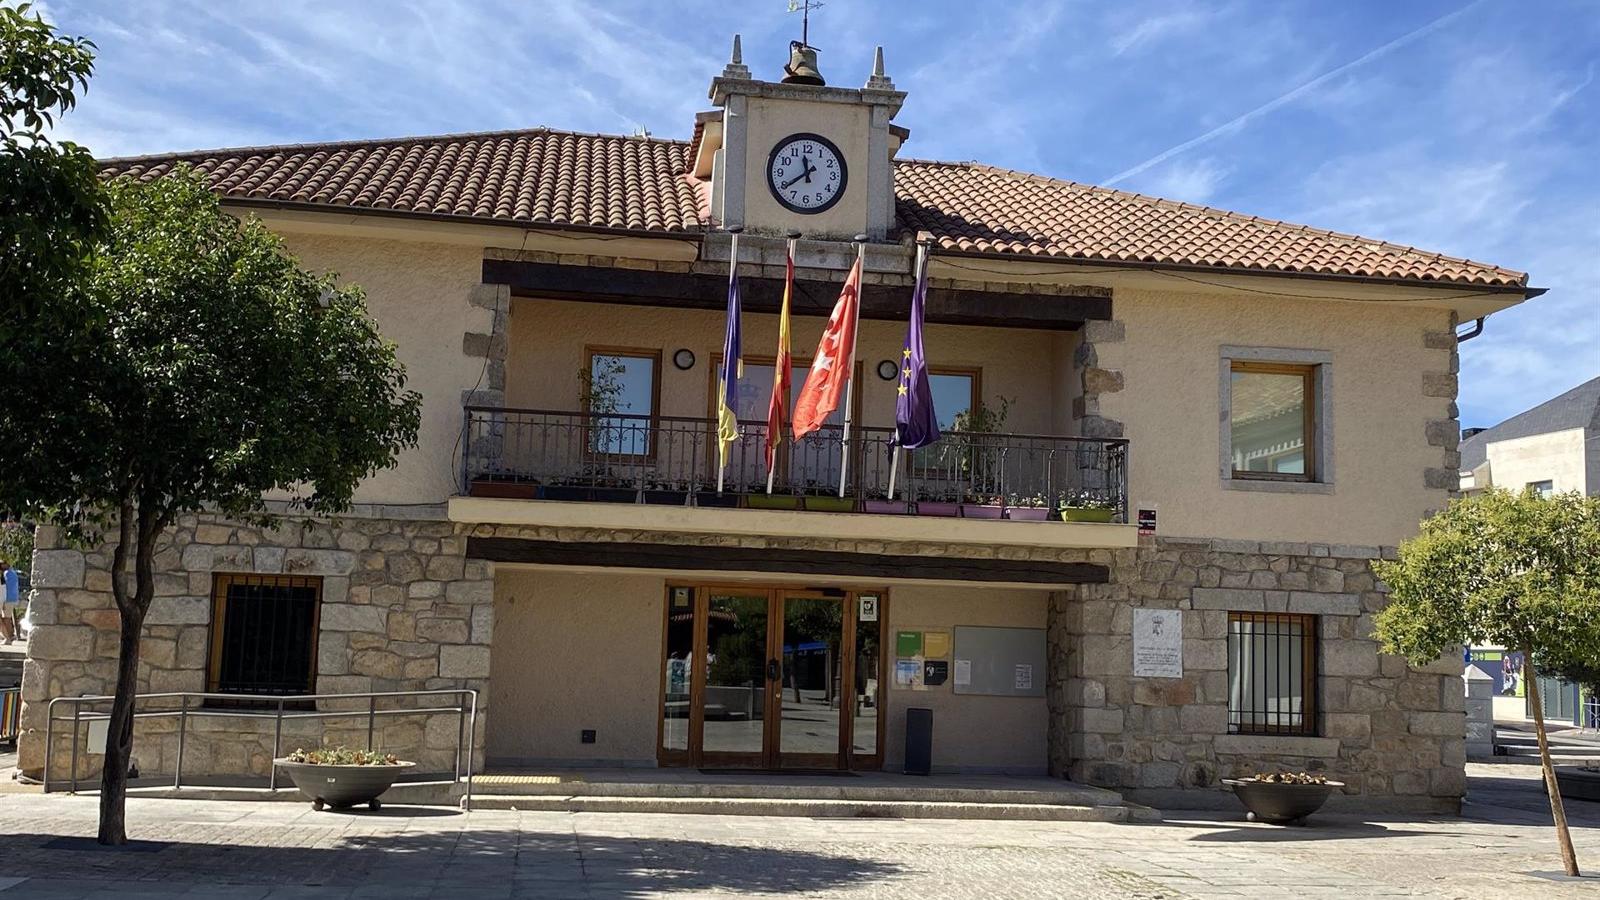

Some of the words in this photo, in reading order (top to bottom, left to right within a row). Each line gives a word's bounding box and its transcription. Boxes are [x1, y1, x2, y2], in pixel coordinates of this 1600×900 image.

[791, 148, 798, 156] 11
[803, 145, 812, 154] 12
[818, 150, 823, 158] 1
[781, 157, 792, 166] 10
[826, 159, 834, 168] 2
[777, 168, 784, 177] 9
[830, 172, 836, 180] 3
[781, 181, 788, 190] 8
[824, 184, 832, 192] 4
[790, 190, 798, 199] 7
[816, 193, 822, 202] 5
[802, 195, 810, 204] 6
